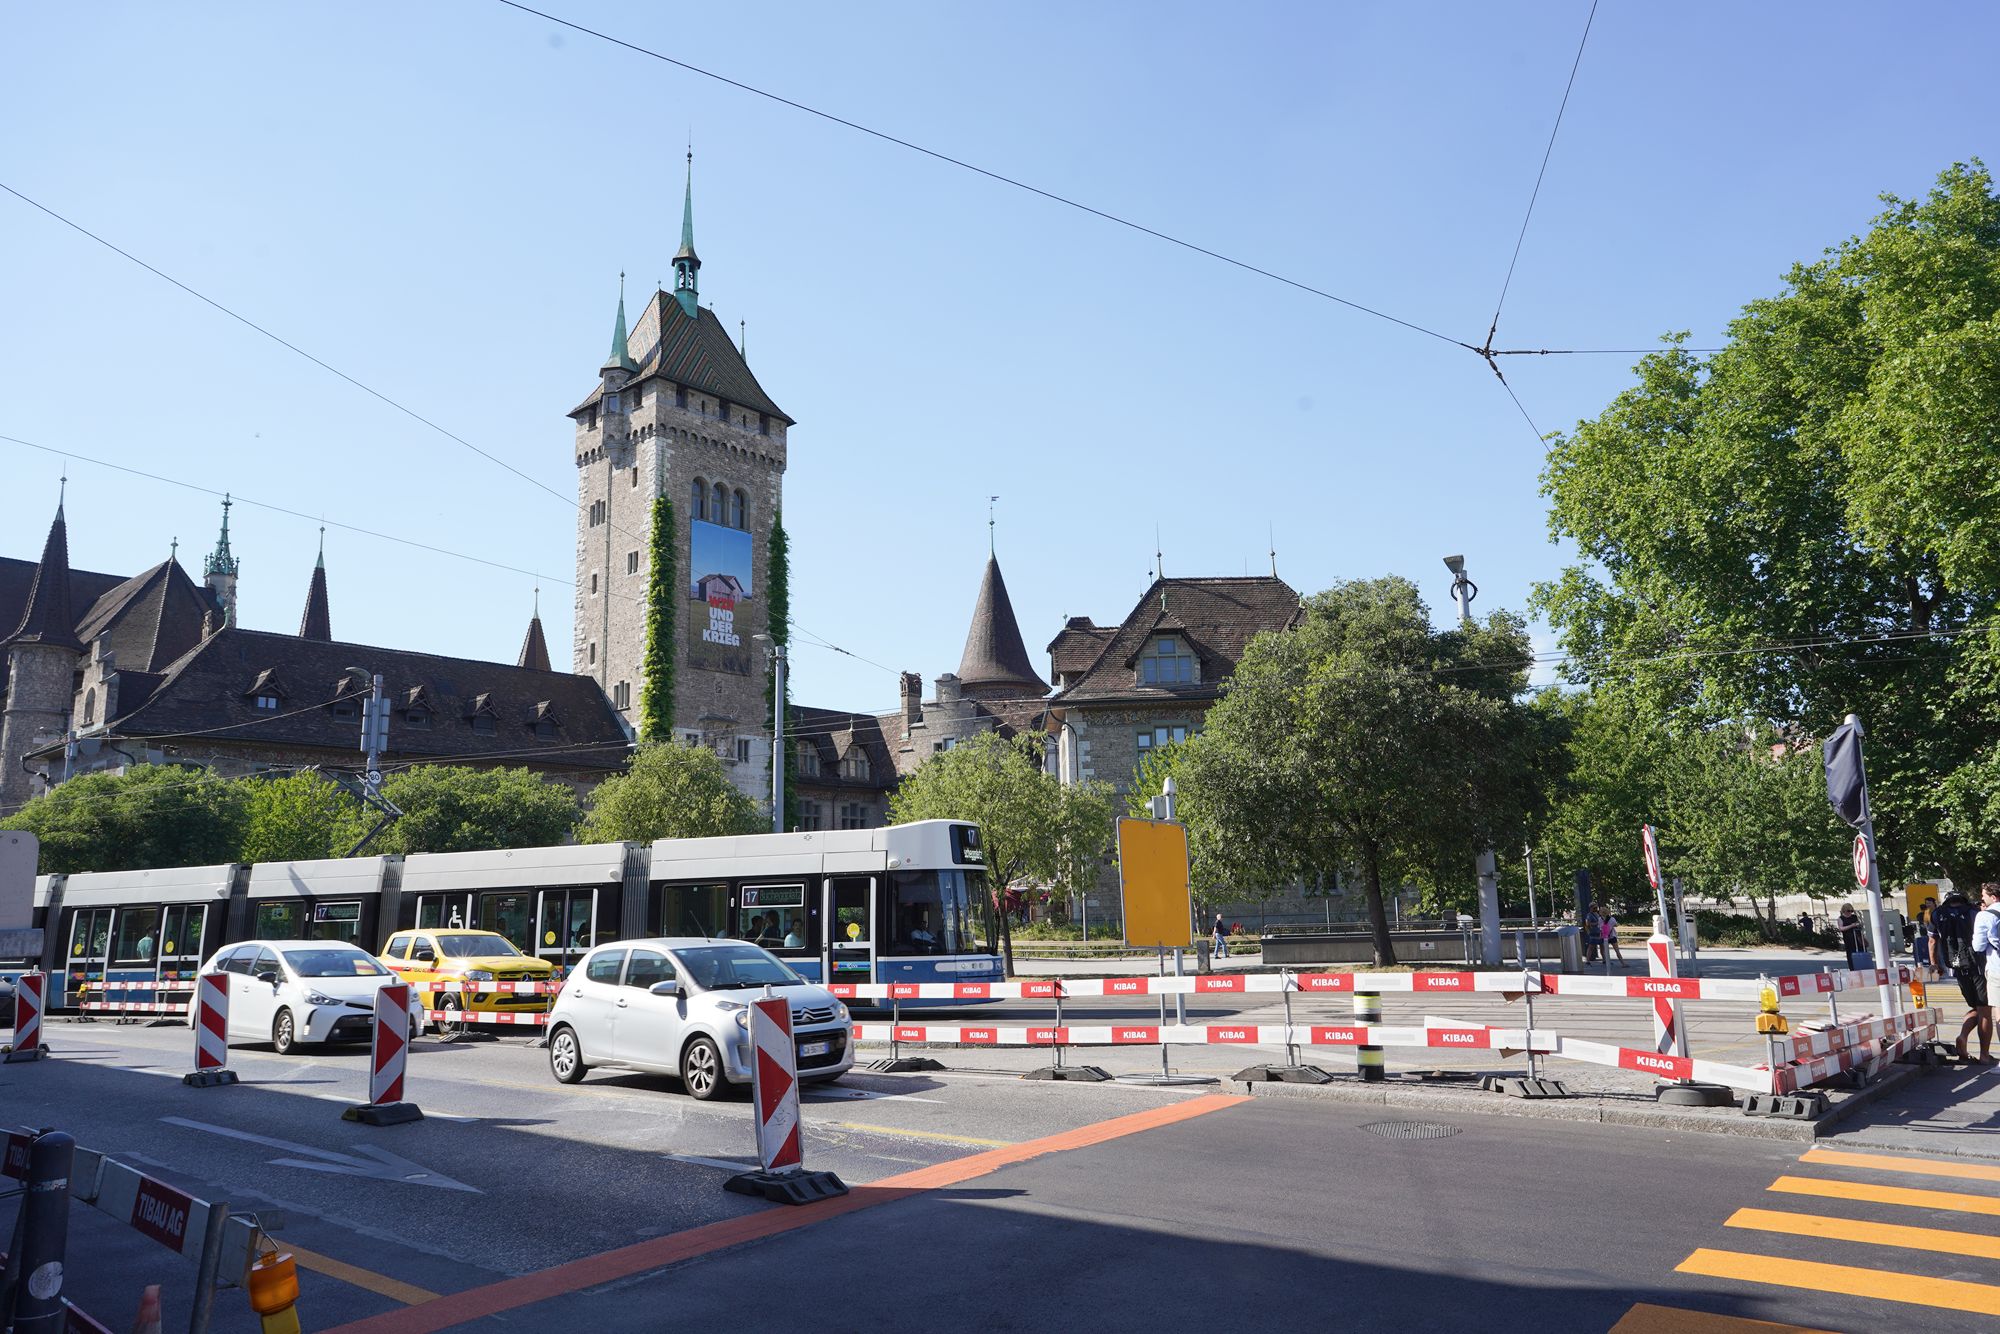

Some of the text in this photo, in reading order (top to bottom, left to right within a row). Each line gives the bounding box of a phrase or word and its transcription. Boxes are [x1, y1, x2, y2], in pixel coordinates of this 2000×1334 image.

[709, 607, 734, 622] UND
[710, 619, 733, 634] DER
[702, 629, 740, 647] KRIEG
[967, 829, 975, 844] 17
[745, 891, 758, 903] 17
[318, 907, 327, 918] 17
[1207, 980, 1233, 988] KIBAG
[1311, 978, 1340, 987] KIBAG
[1427, 977, 1460, 987] KIBAG
[1030, 985, 1052, 993] KIBAG
[1644, 983, 1682, 993] KIBAG
[969, 1031, 989, 1039] KIBAG
[1123, 1031, 1147, 1039] KIBAG
[1219, 1031, 1246, 1039] KIBAG
[1325, 1031, 1354, 1041] KIBAG
[1442, 1033, 1475, 1043] KIBAG
[1636, 1056, 1674, 1070] KIBAG
[138, 1193, 184, 1237] TIBAU AG
